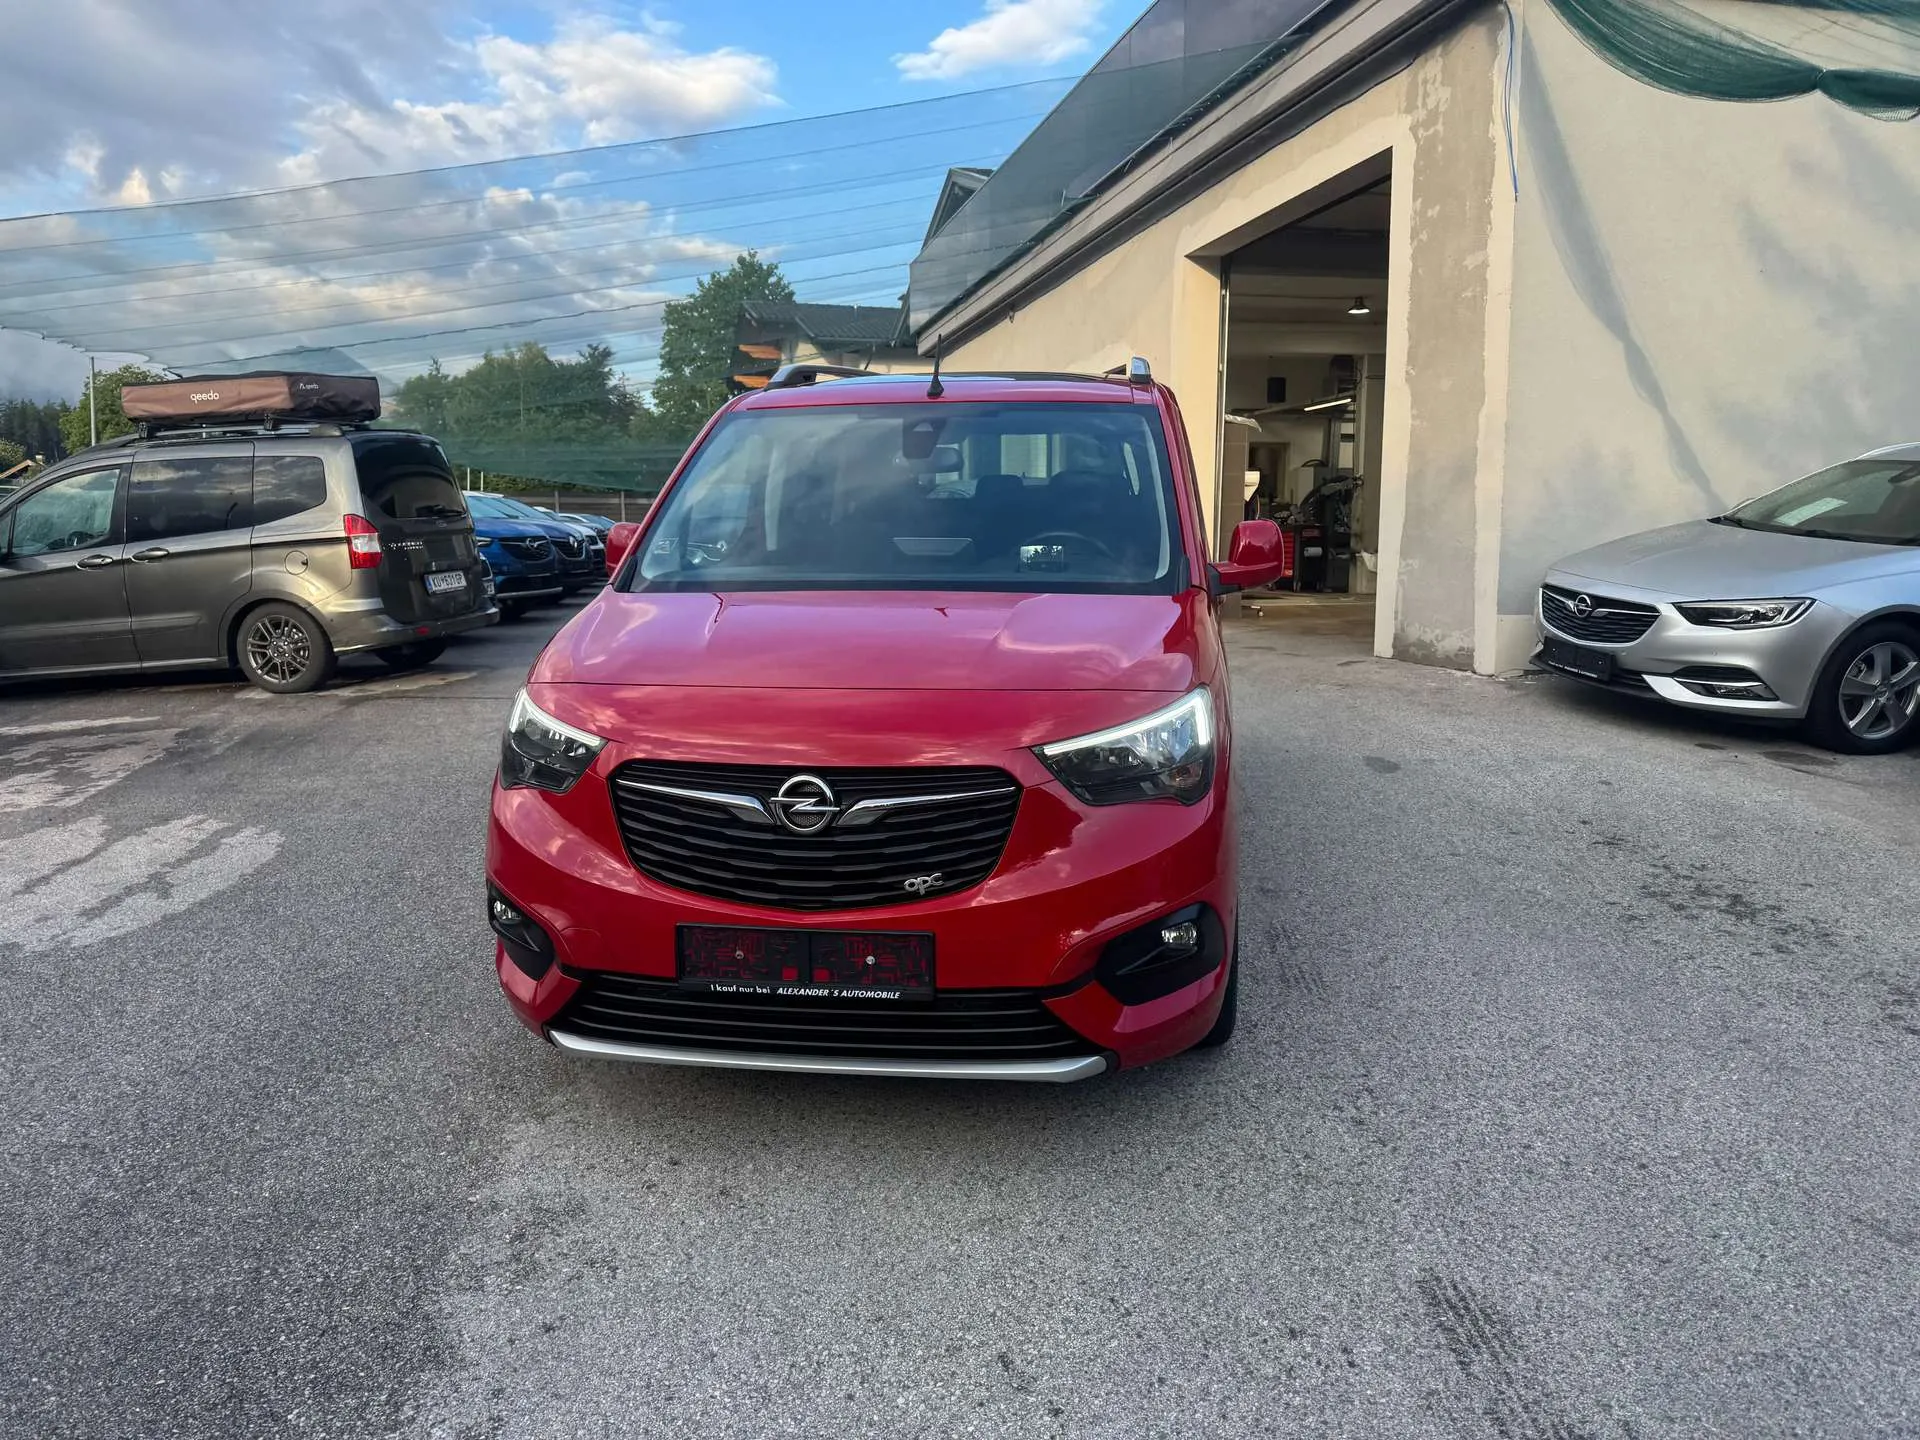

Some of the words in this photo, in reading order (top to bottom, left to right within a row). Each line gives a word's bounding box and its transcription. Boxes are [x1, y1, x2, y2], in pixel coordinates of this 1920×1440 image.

[190, 389, 219, 404] qeedo
[716, 983, 737, 992] kauf
[756, 985, 770, 993] bei
[840, 989, 900, 999] AUTOMOBILE
